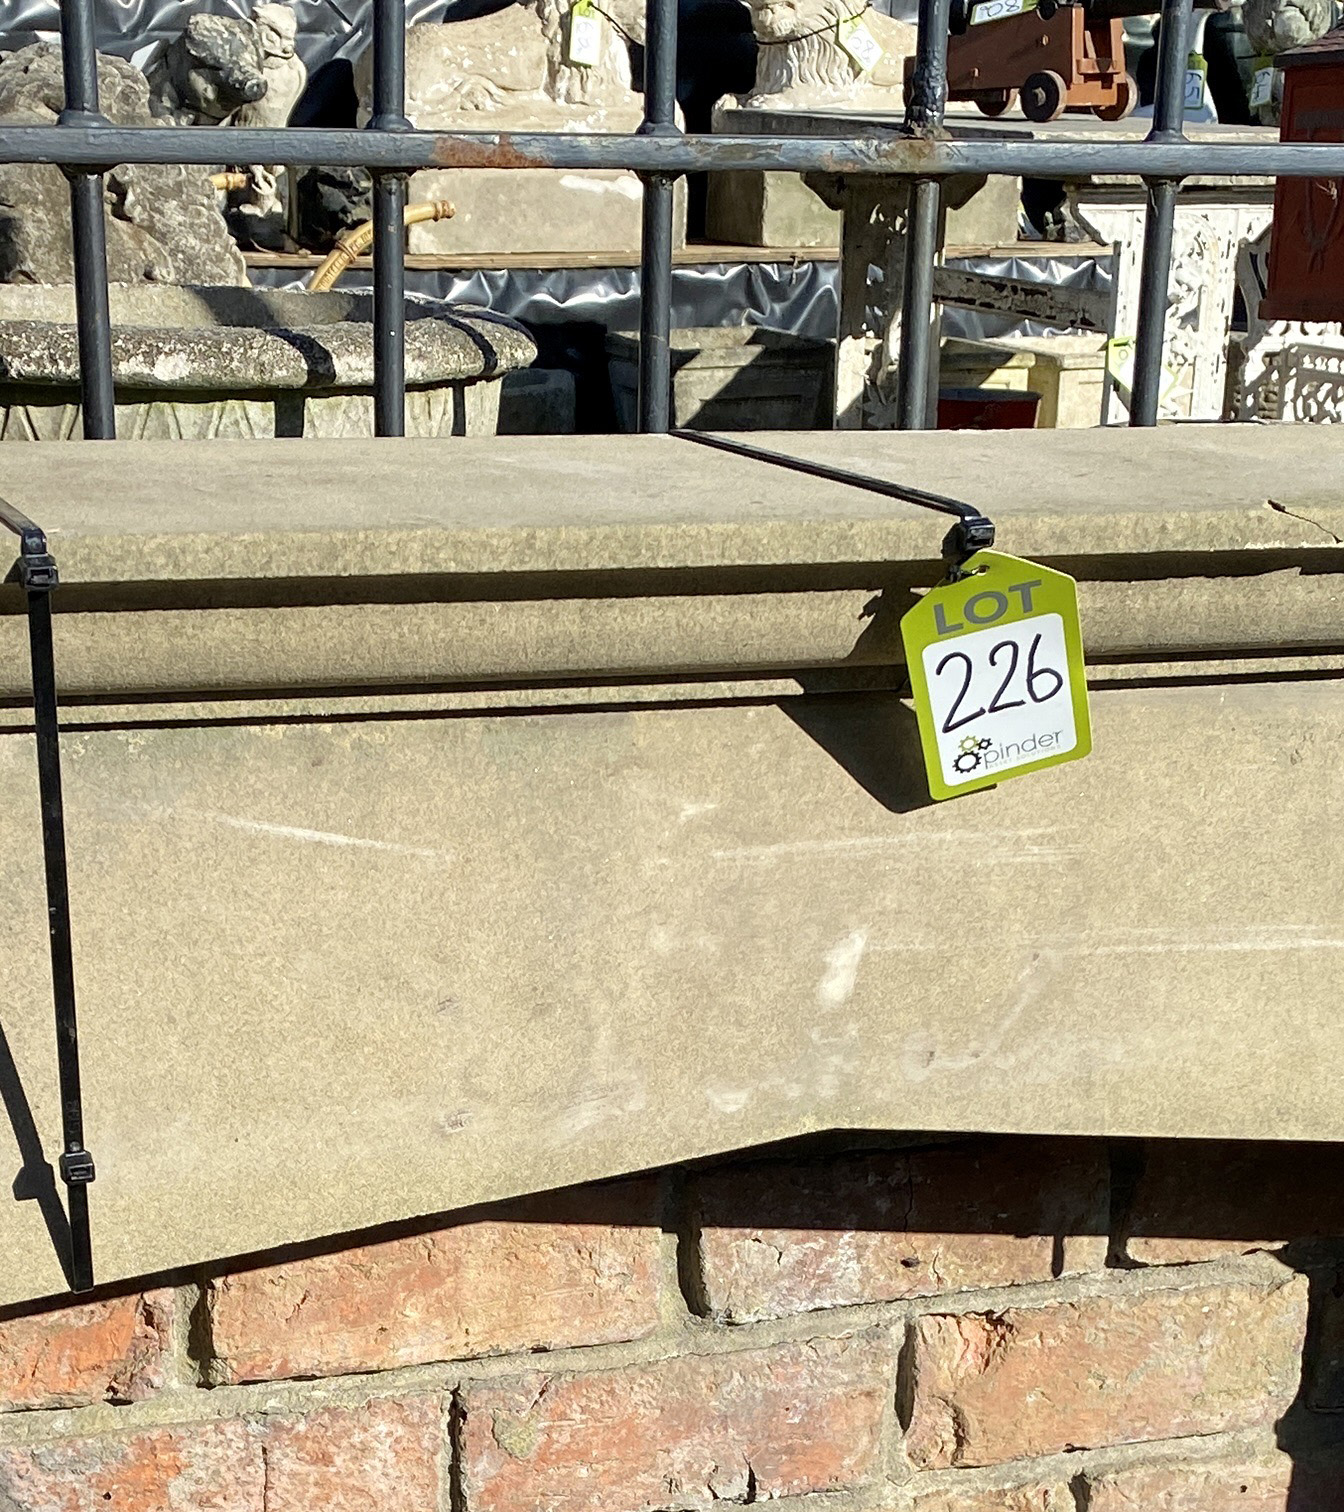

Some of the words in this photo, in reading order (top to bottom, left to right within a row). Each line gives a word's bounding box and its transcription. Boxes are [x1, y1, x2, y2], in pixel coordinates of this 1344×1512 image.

[933, 579, 1042, 636] LOT
[935, 633, 1064, 734] 226
[983, 730, 1063, 770] pinder
